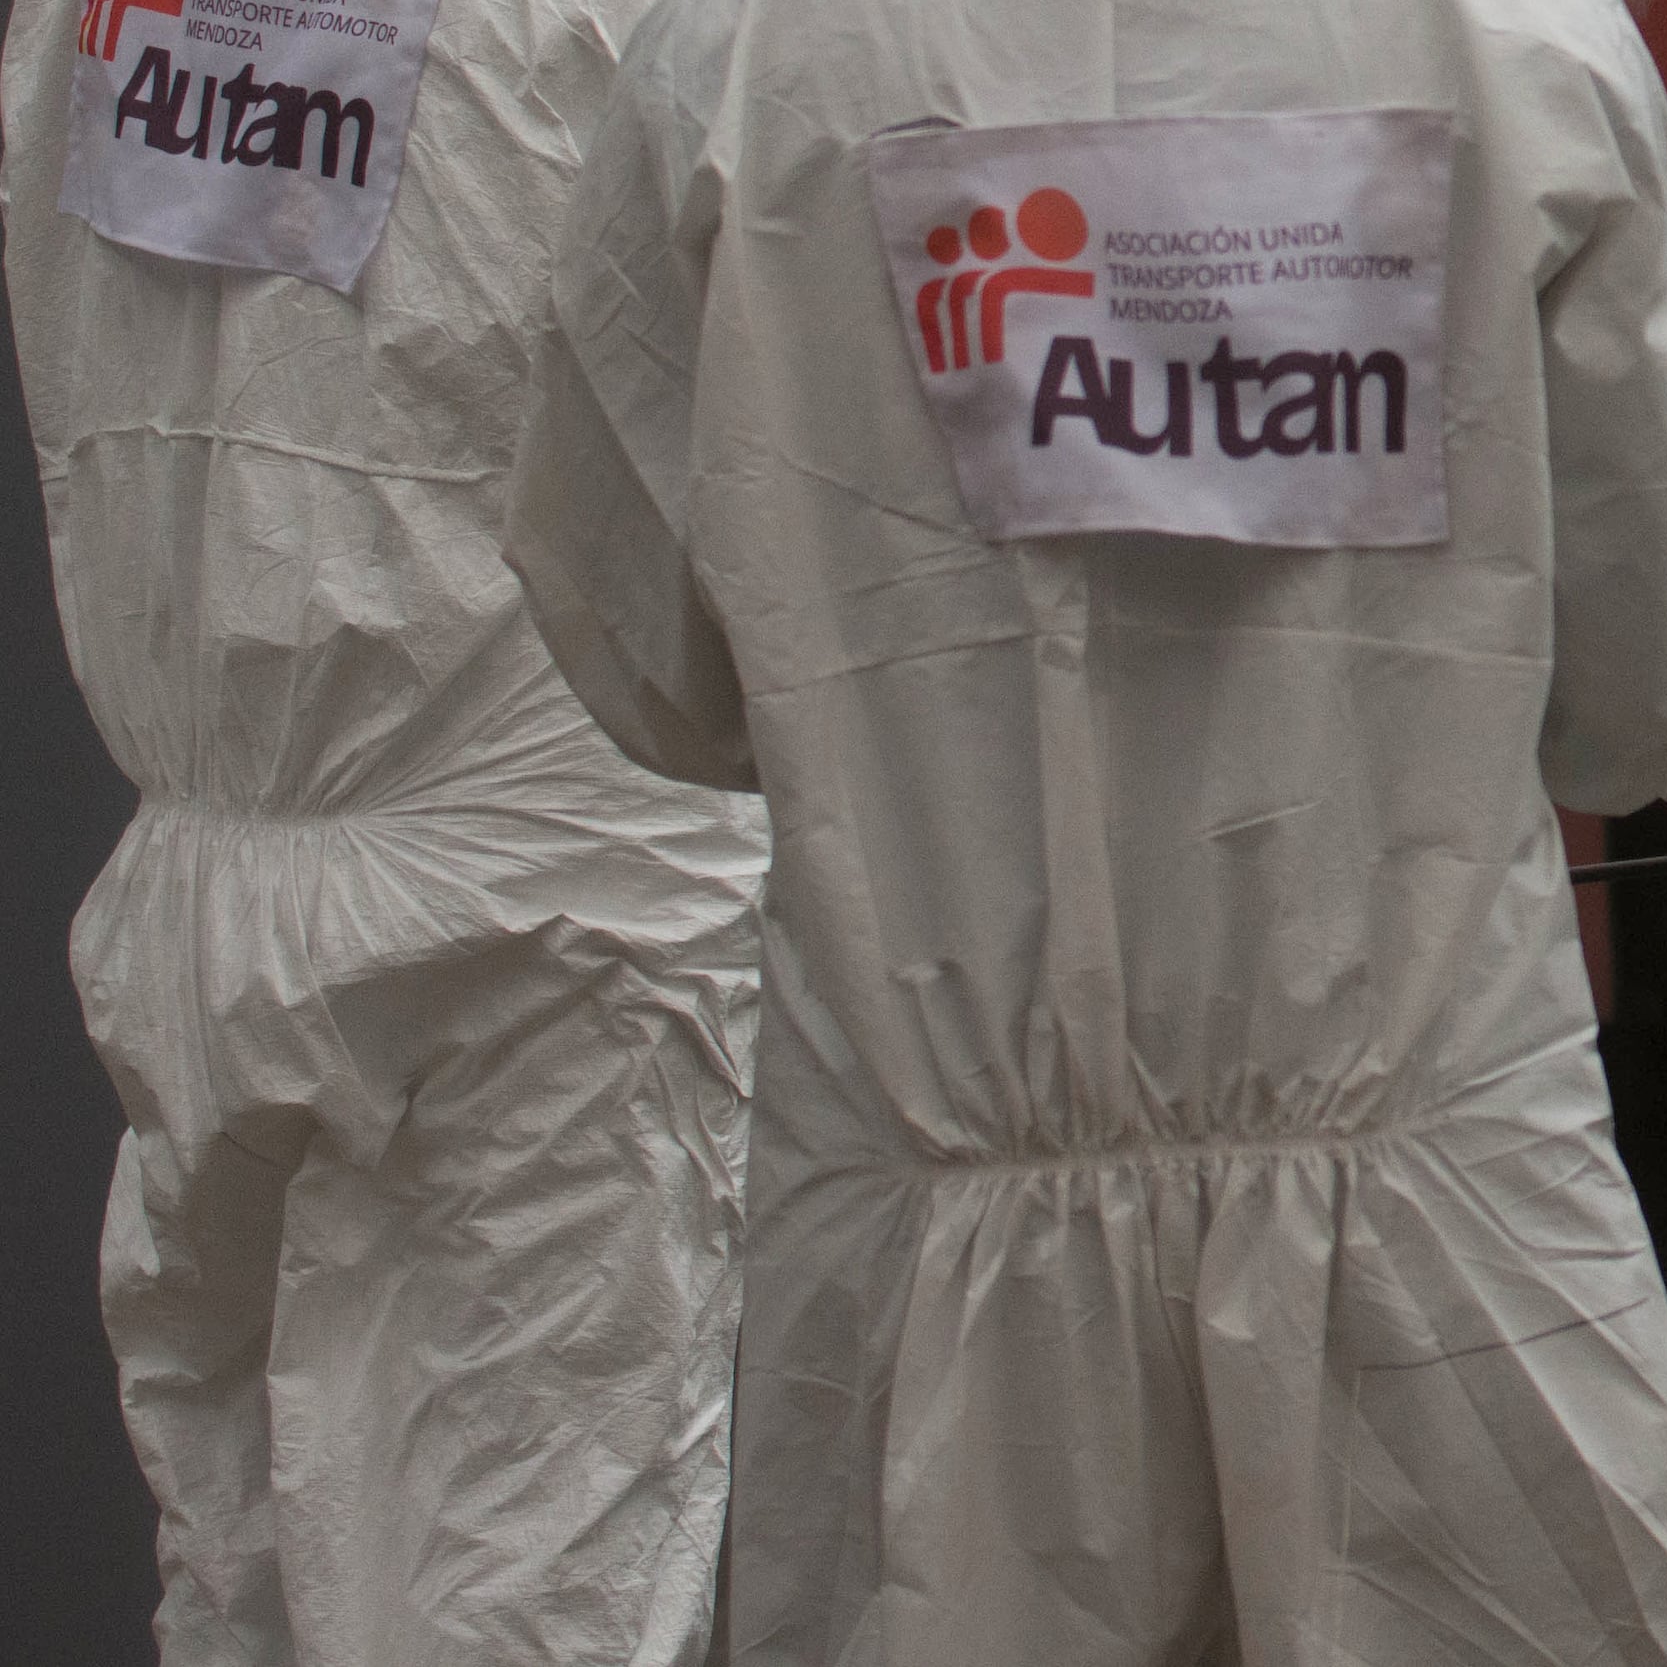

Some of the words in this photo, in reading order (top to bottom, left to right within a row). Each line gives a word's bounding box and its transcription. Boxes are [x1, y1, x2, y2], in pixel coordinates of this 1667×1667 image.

[186, 18, 263, 51] MENDOZA
[295, 11, 399, 45] AUTOMOTOR
[115, 45, 375, 188] Autam
[1105, 224, 1251, 256] ASOCIACIÓN
[1258, 222, 1344, 252] UNIDA
[1107, 259, 1265, 290] TRANSPORTE
[1274, 253, 1414, 281] AUTOMOTOR
[1110, 297, 1234, 323] MENDOZA
[1031, 335, 1407, 460] Autam
